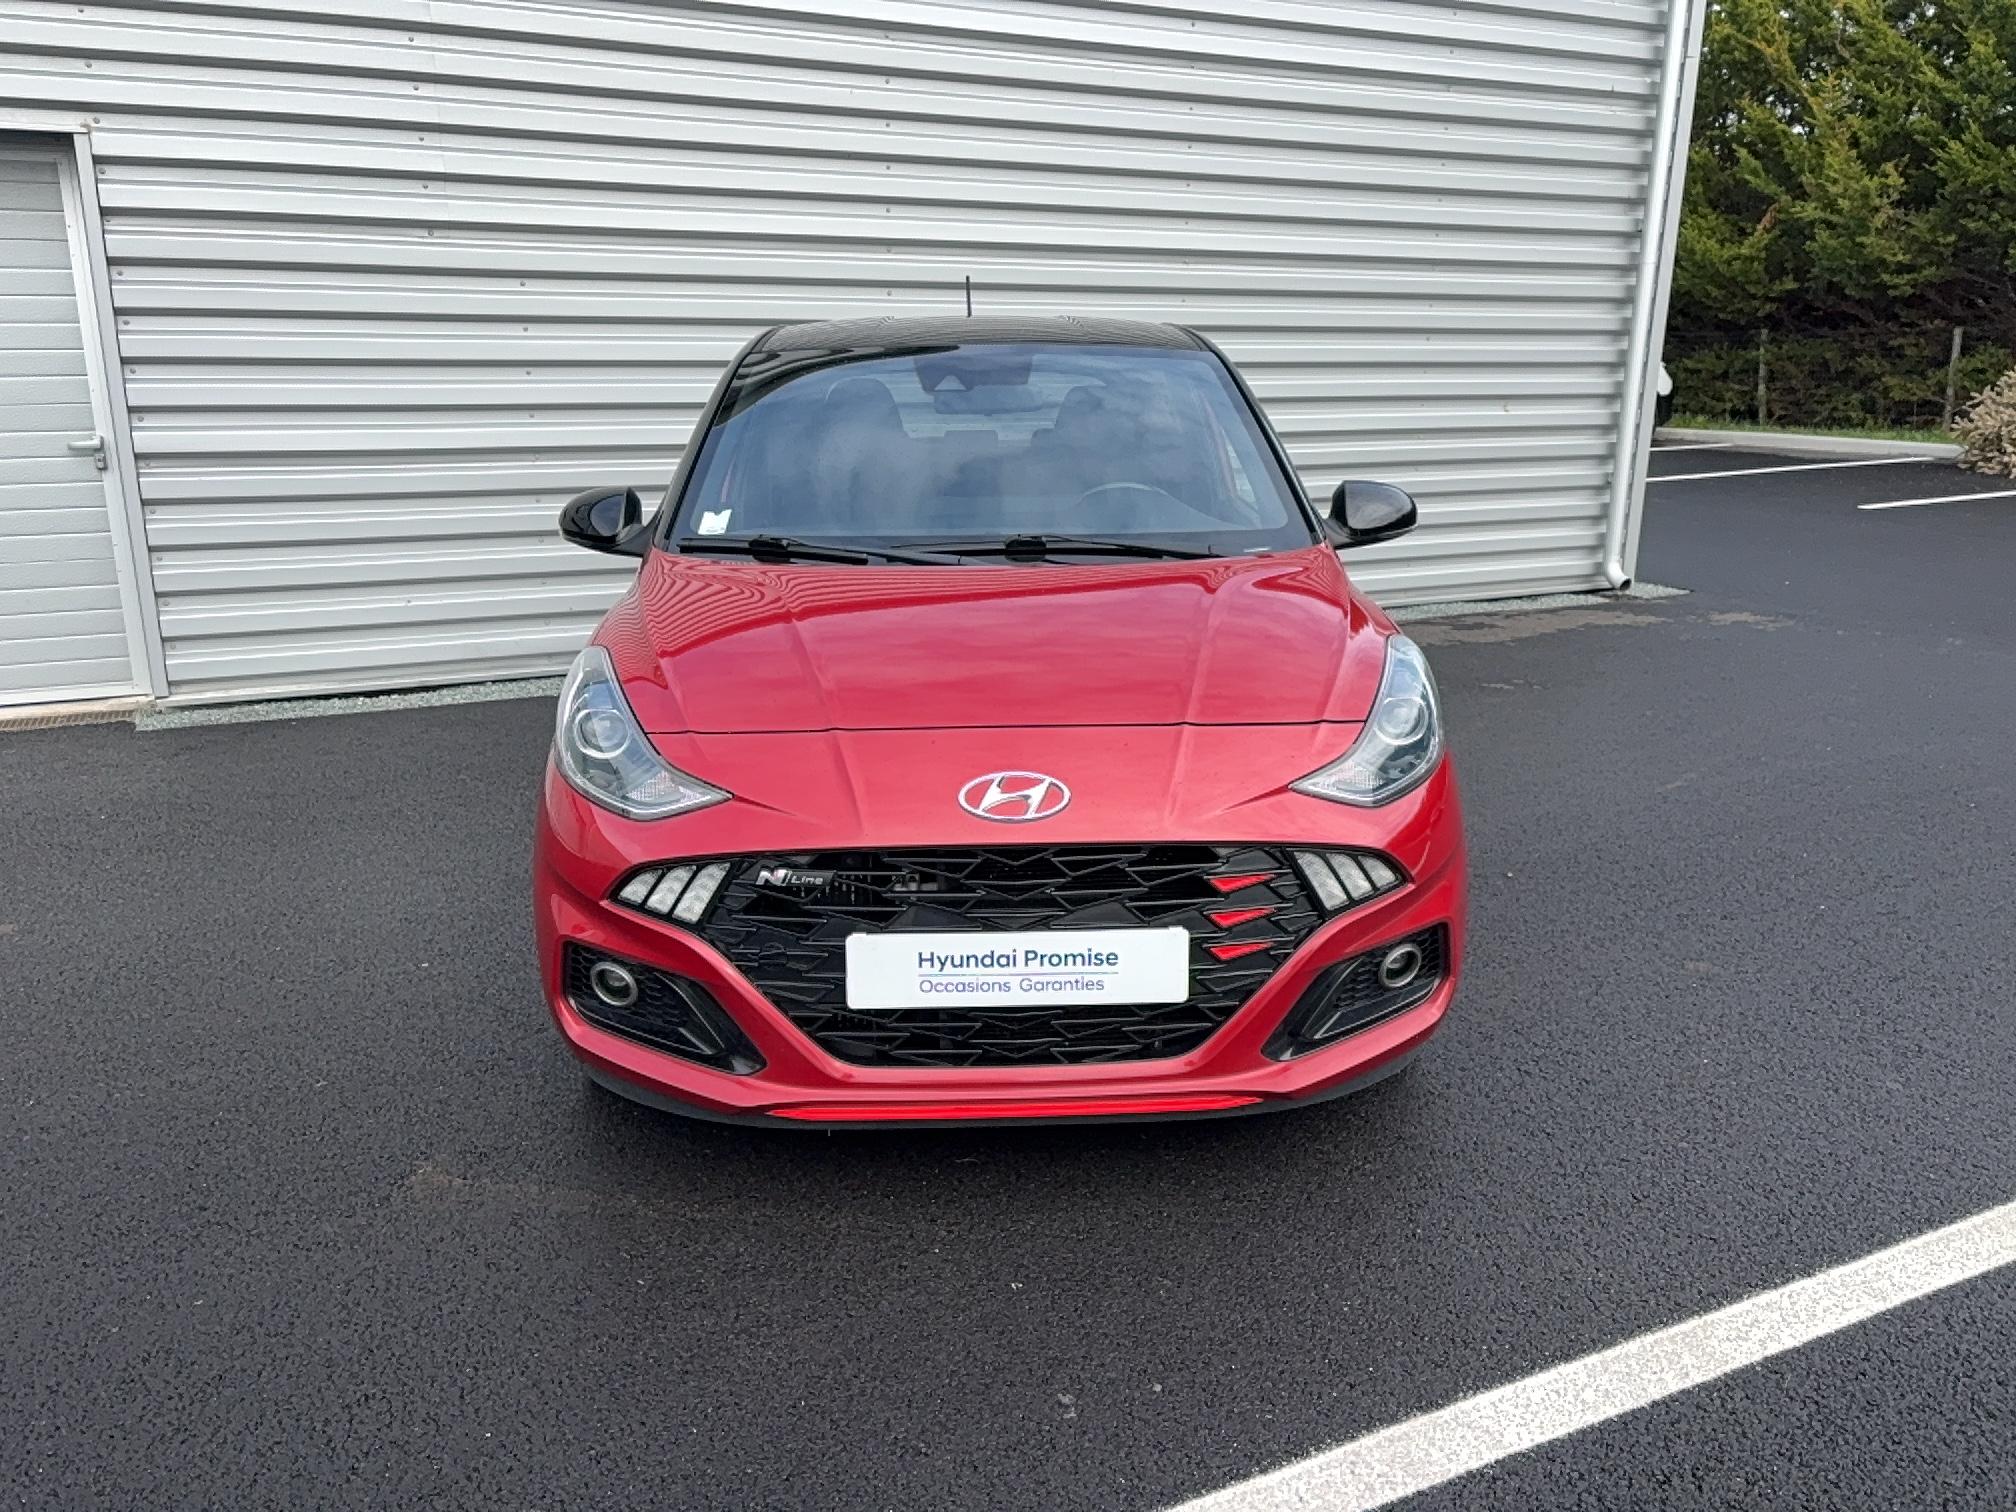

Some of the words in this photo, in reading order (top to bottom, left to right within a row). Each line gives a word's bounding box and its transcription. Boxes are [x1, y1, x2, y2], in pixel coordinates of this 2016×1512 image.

[791, 875, 823, 885] Line
[918, 949, 1017, 972] Hyundai
[1024, 948, 1119, 968] Promise
[919, 978, 1011, 993] Occasions
[1019, 976, 1105, 992] Garanties
